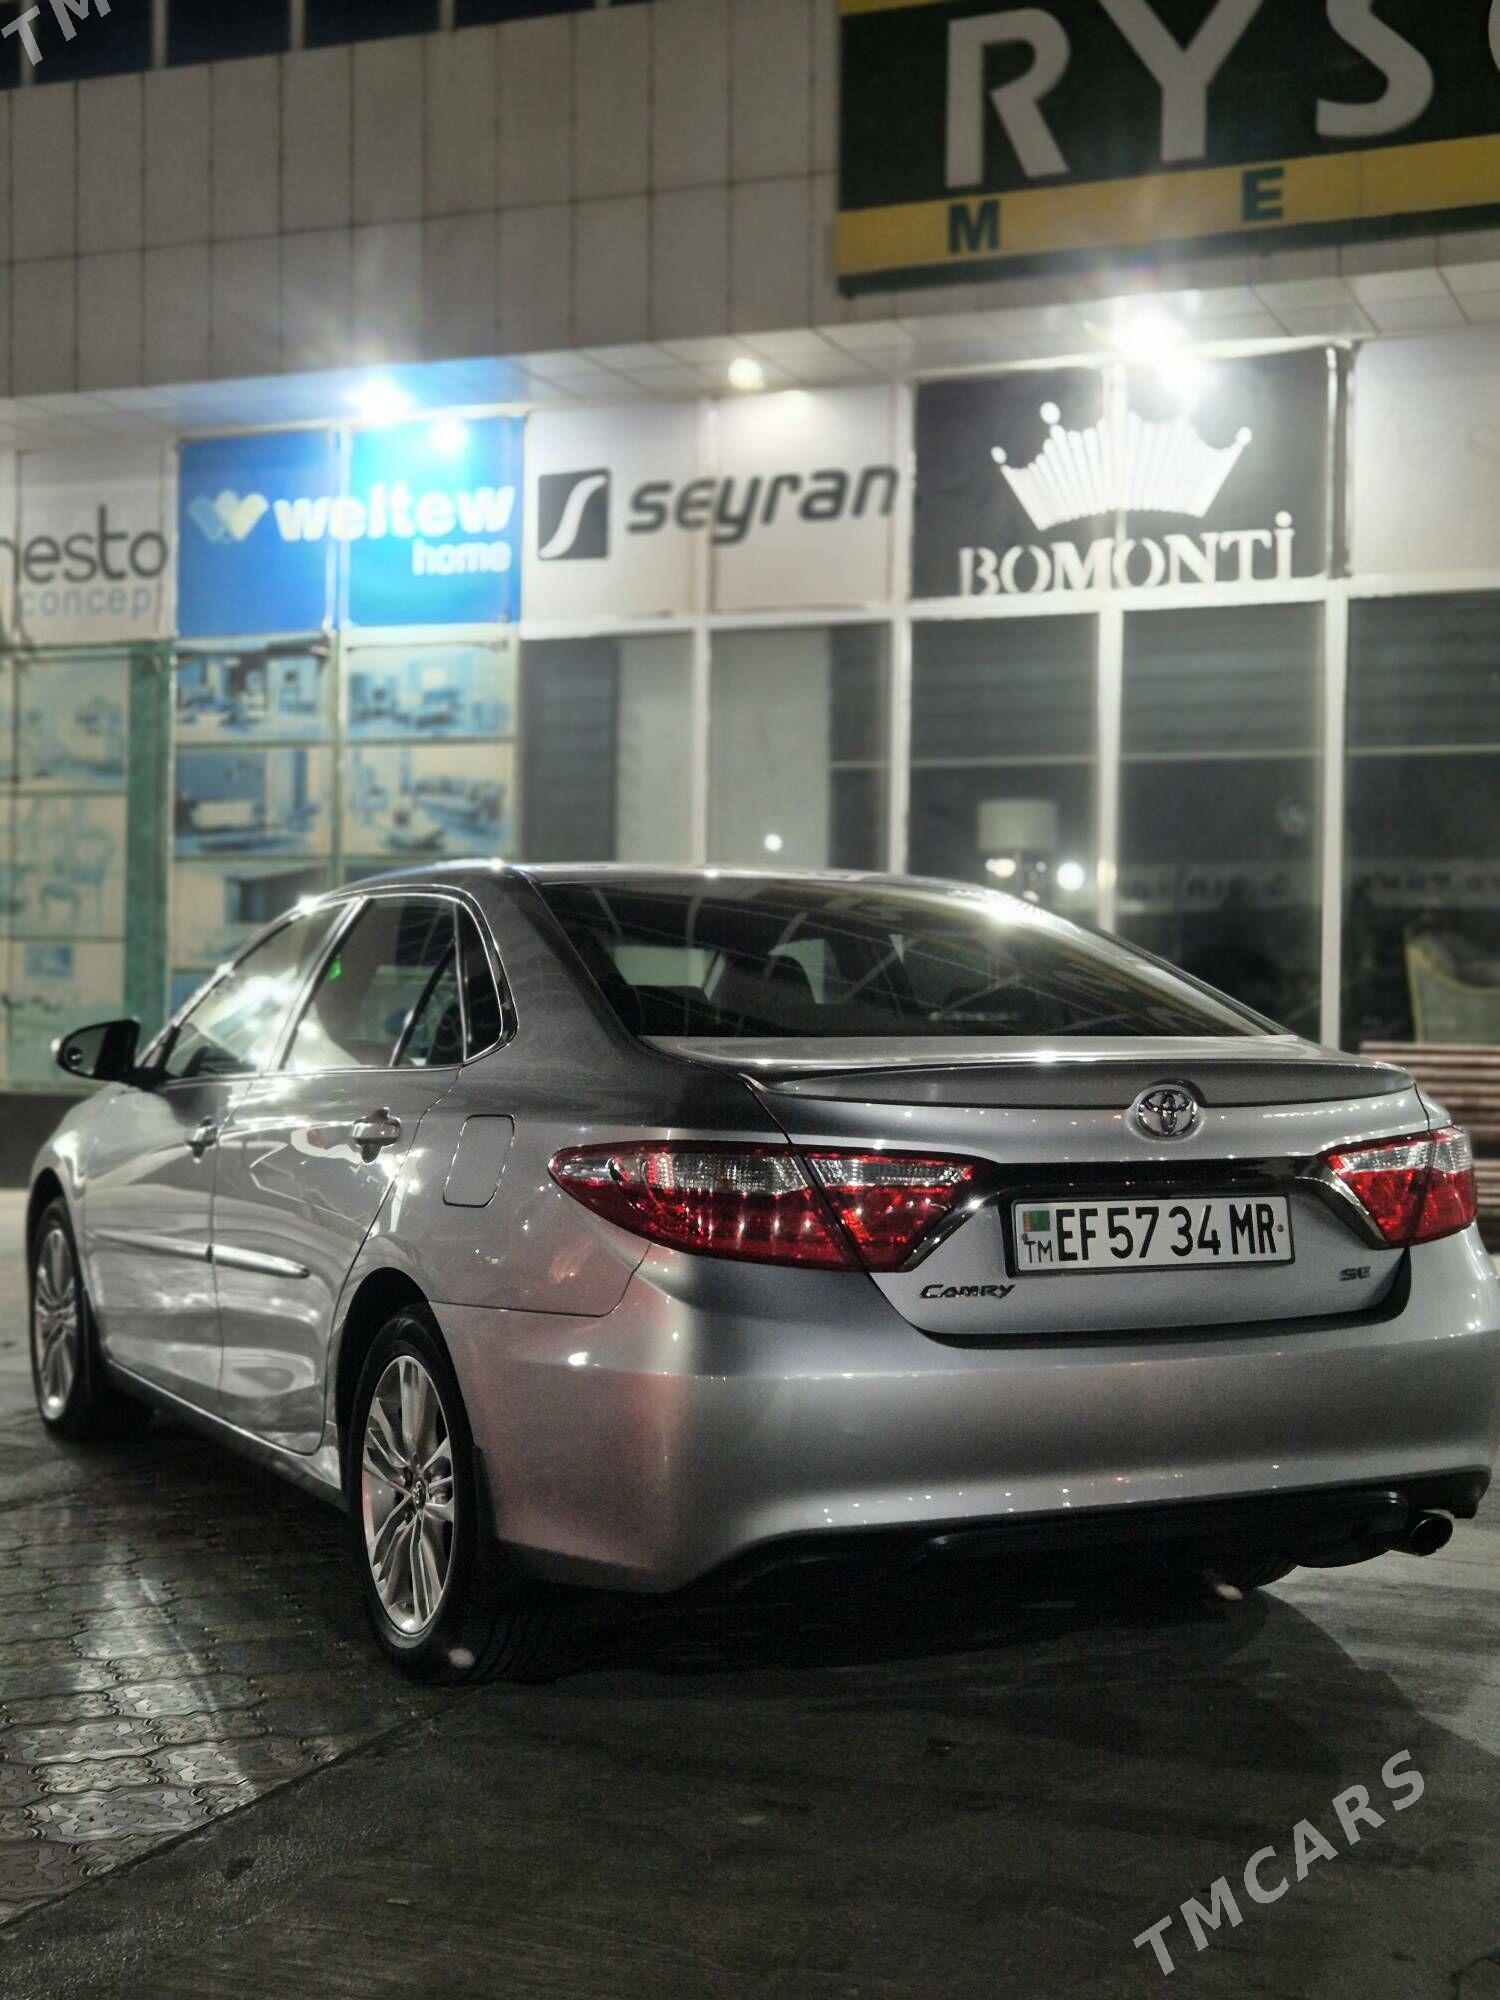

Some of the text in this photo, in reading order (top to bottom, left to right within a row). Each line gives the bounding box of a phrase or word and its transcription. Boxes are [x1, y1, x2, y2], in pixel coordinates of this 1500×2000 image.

[945, 0, 1500, 188] RYS
[274, 482, 516, 542] weltew
[626, 464, 899, 545] seyran
[411, 537, 513, 577] home
[1023, 1239, 1054, 1264] TM
[1339, 1265, 1371, 1281] SE
